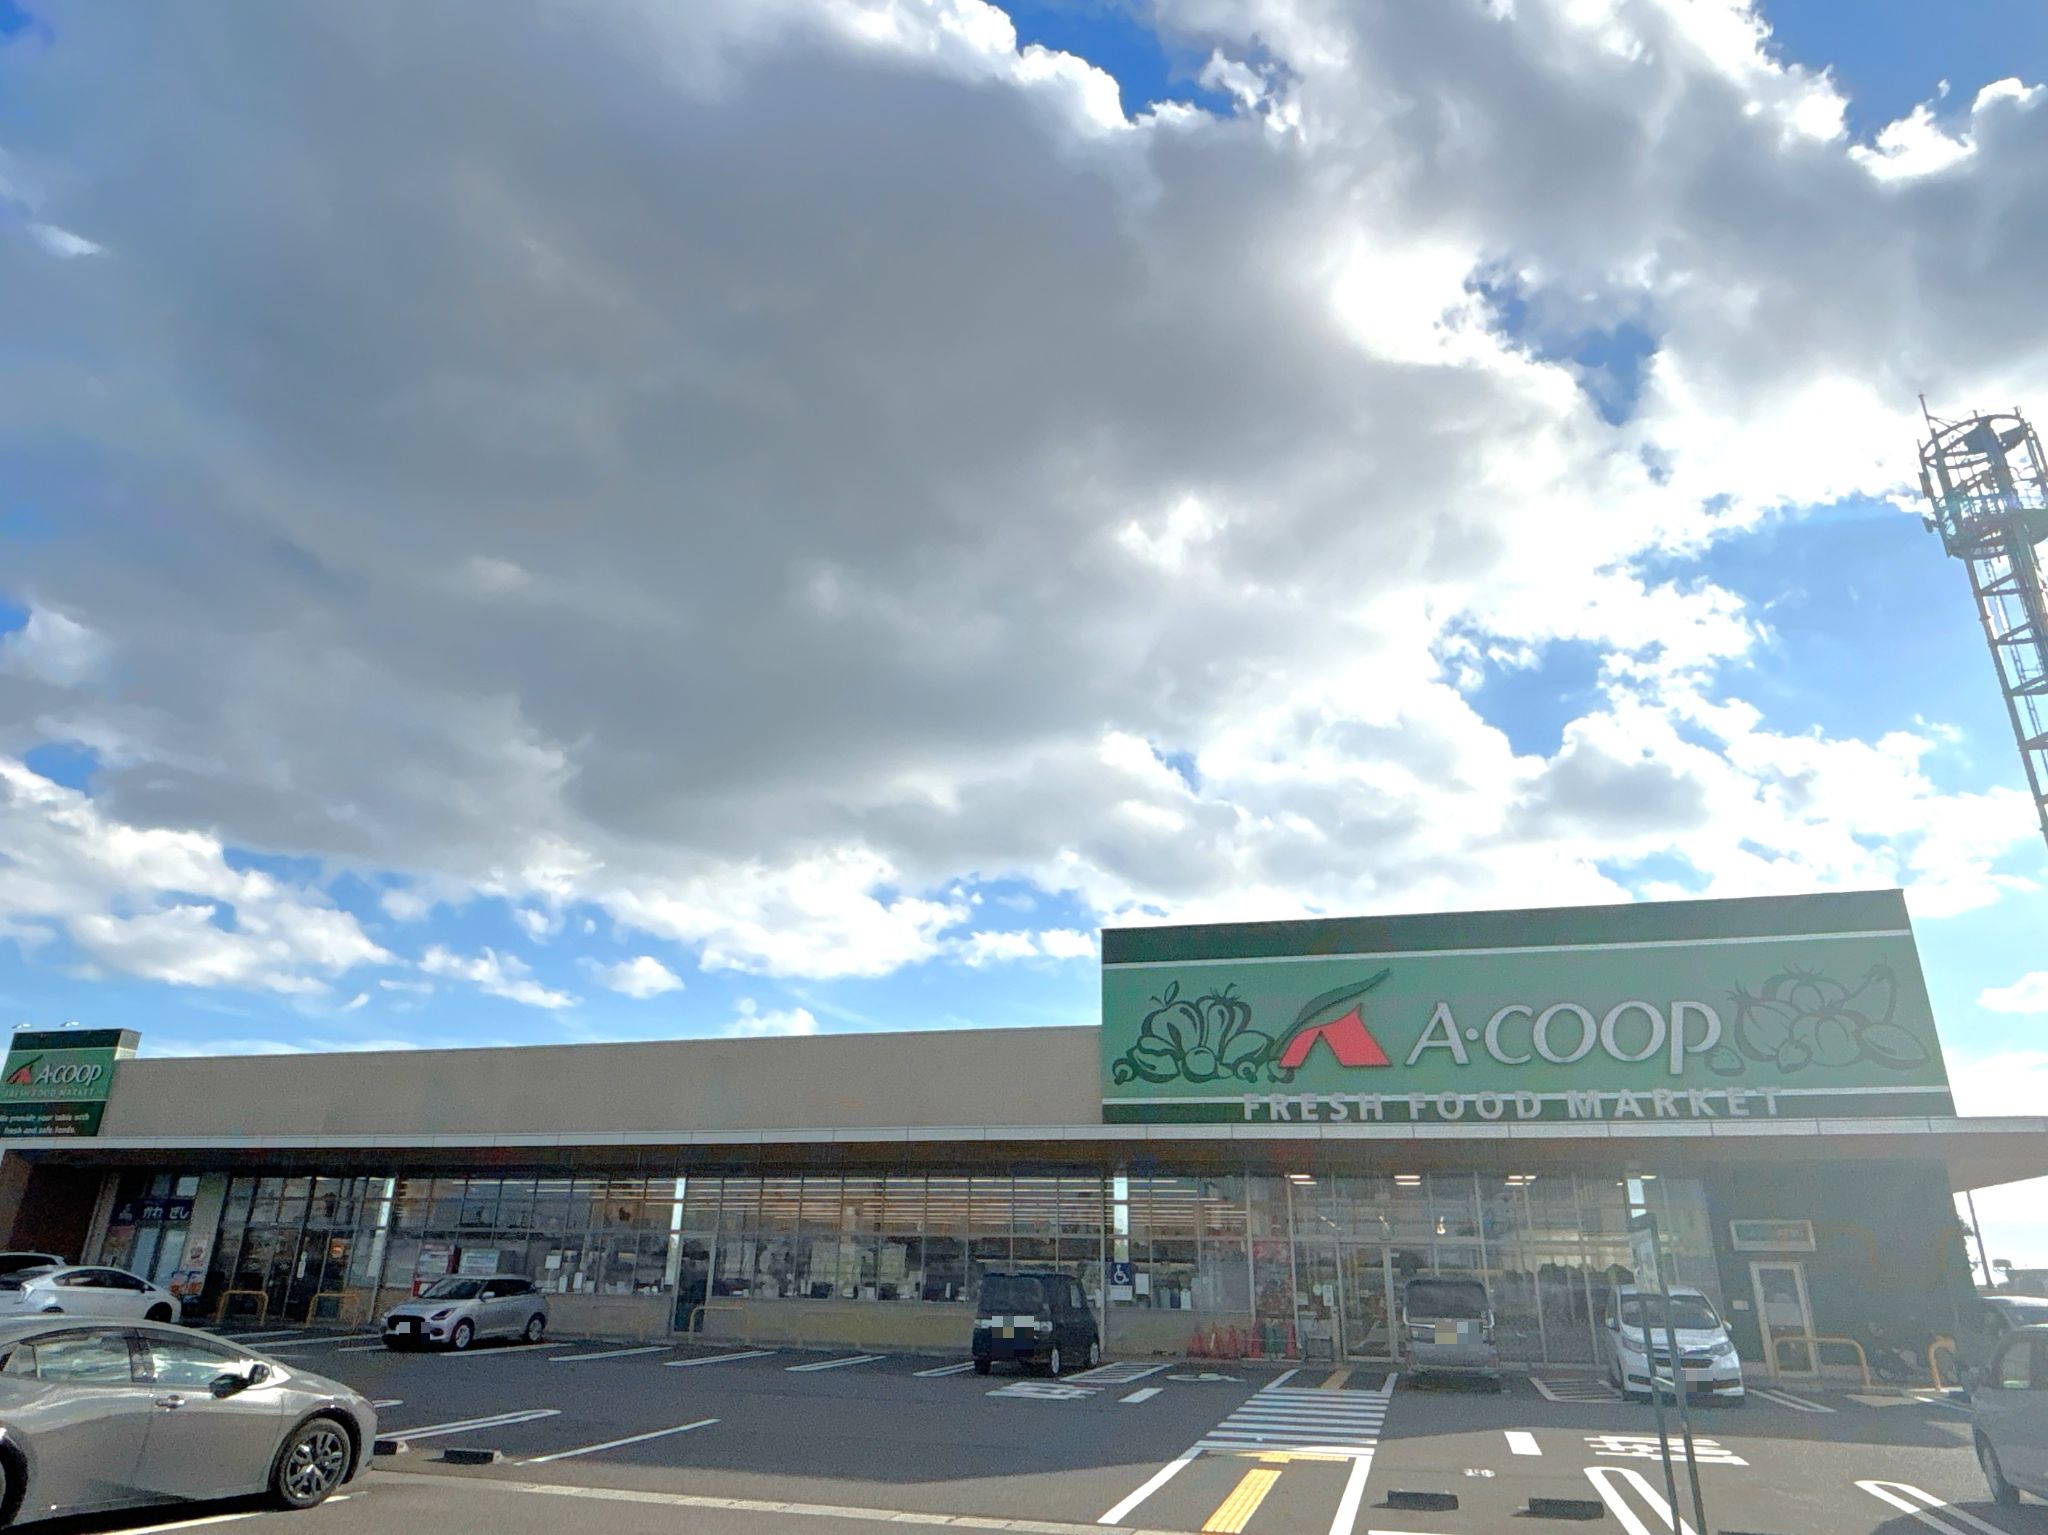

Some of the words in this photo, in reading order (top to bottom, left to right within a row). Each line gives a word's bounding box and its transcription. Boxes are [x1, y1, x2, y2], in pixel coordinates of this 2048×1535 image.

[1243, 1092, 1384, 1121] FRESH
[1409, 1090, 1543, 1120] FOOD
[1566, 1086, 1781, 1119] MARKET
